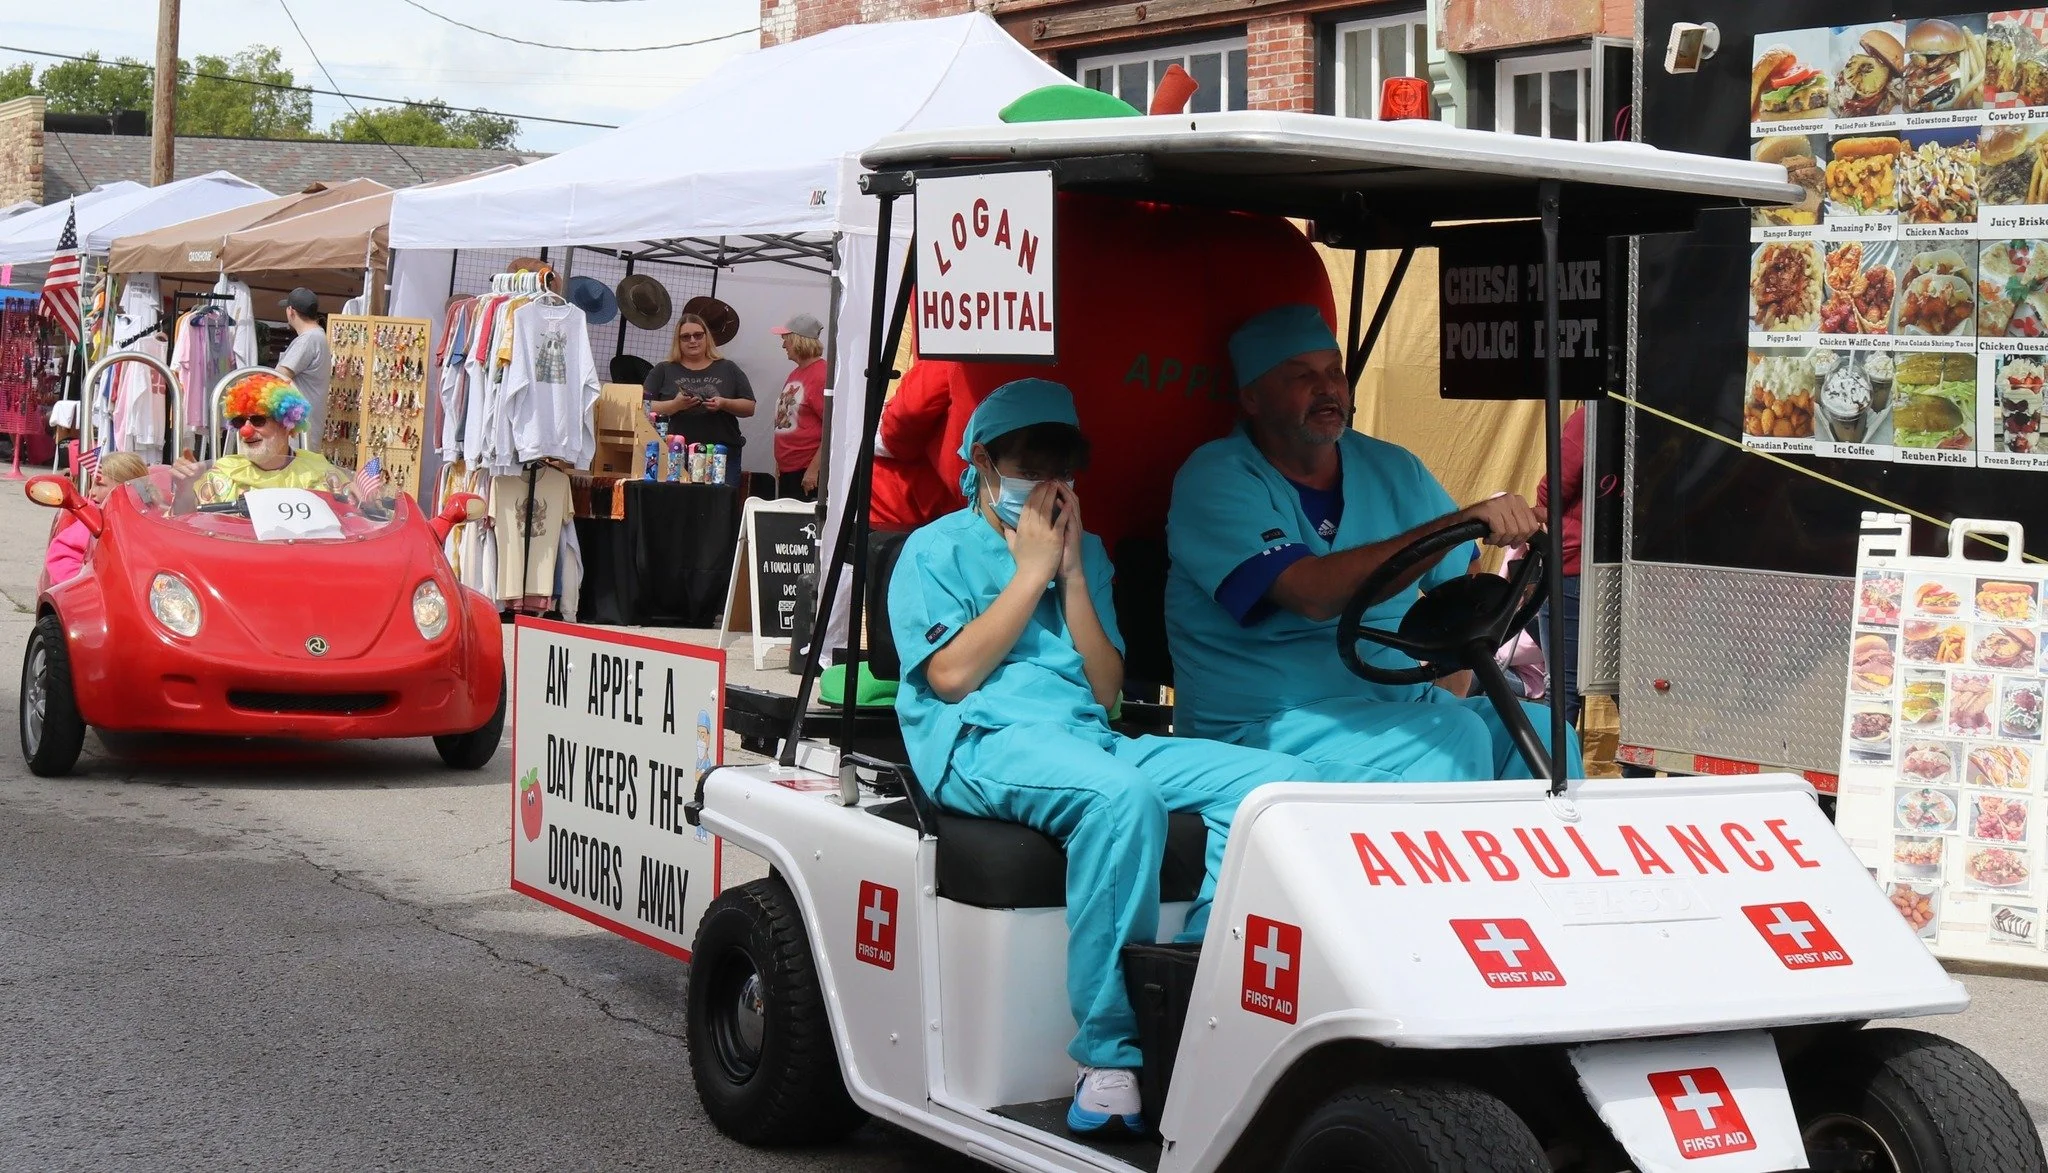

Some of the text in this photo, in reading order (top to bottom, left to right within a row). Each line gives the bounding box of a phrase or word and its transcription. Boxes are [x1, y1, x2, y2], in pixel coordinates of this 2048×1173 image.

[1906, 114, 1978, 125] Yellowstone Burger
[1988, 111, 2026, 121] Cowboy
[1756, 124, 1824, 134] Angus Cheeseburger
[1834, 122, 1854, 130] Pulled
[1830, 224, 1864, 233] Amazing
[1877, 223, 1892, 232] Boy
[1990, 217, 2017, 228] Juicy
[933, 198, 1039, 277] LOGAN
[1763, 229, 1812, 238] Ranger Burger
[1905, 227, 1969, 236] Chicken Nachos
[923, 291, 1052, 332] HOSPITAL
[1767, 335, 1785, 343] Piggy
[1819, 337, 1891, 347] Chicken Waffle Cone
[1931, 340, 1954, 348] Shrimp
[1979, 341, 2015, 351] Chicken
[1746, 441, 1813, 451] Canadian Poutine
[1833, 444, 1875, 456] Ice Coffee
[1901, 450, 1967, 463] Reuben Pickle
[1984, 456, 2048, 467] Frozen Berry Par
[278, 502, 311, 521] 99
[763, 560, 769, 573] A
[770, 561, 791, 574] TOUCH
[545, 644, 675, 735] AN APPLE A
[547, 733, 683, 835] DAY KEEPS THE
[1350, 819, 1821, 886] AMBULANCE
[549, 824, 689, 935] DOCTORS AWAY
[858, 942, 892, 963] FIRST AID
[1784, 950, 1844, 965] FIRST AID
[1487, 971, 1556, 983] FIRST AID
[1245, 989, 1293, 1015] FIRST AID
[1682, 1131, 1748, 1152] FIRST AID
